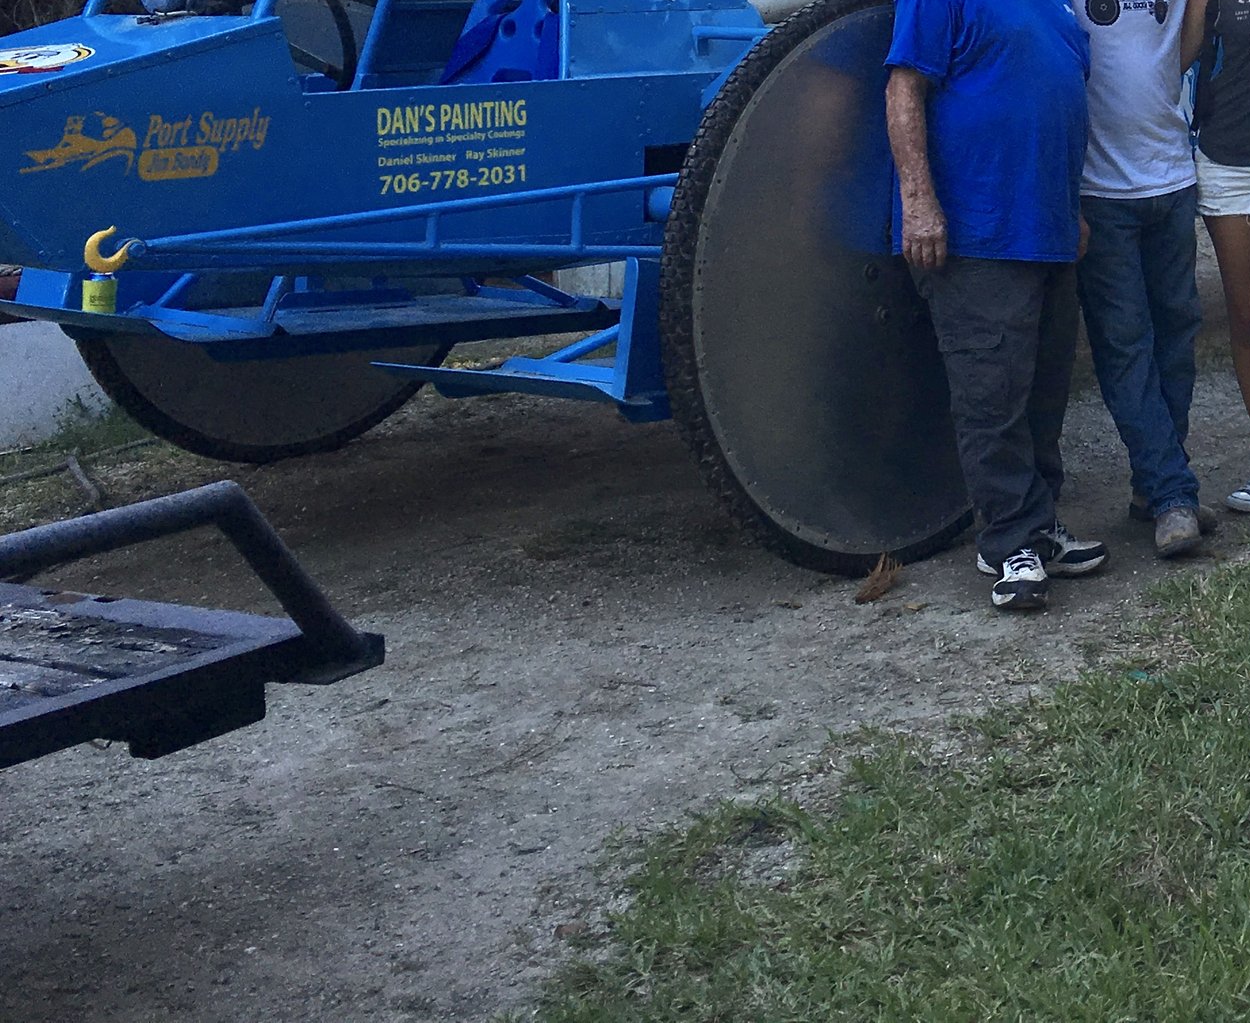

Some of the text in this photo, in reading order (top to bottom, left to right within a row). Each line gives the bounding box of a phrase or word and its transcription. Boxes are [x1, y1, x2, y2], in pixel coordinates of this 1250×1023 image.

[143, 106, 271, 152] Port Supply
[376, 98, 527, 136] DAN'S PAINTING
[378, 136, 433, 149] Specializing
[446, 131, 486, 144] Specialty
[487, 129, 526, 140] Coatings
[378, 147, 526, 167] Daniel Skinner Ray Skinner
[379, 163, 527, 195] 706-778-2031
